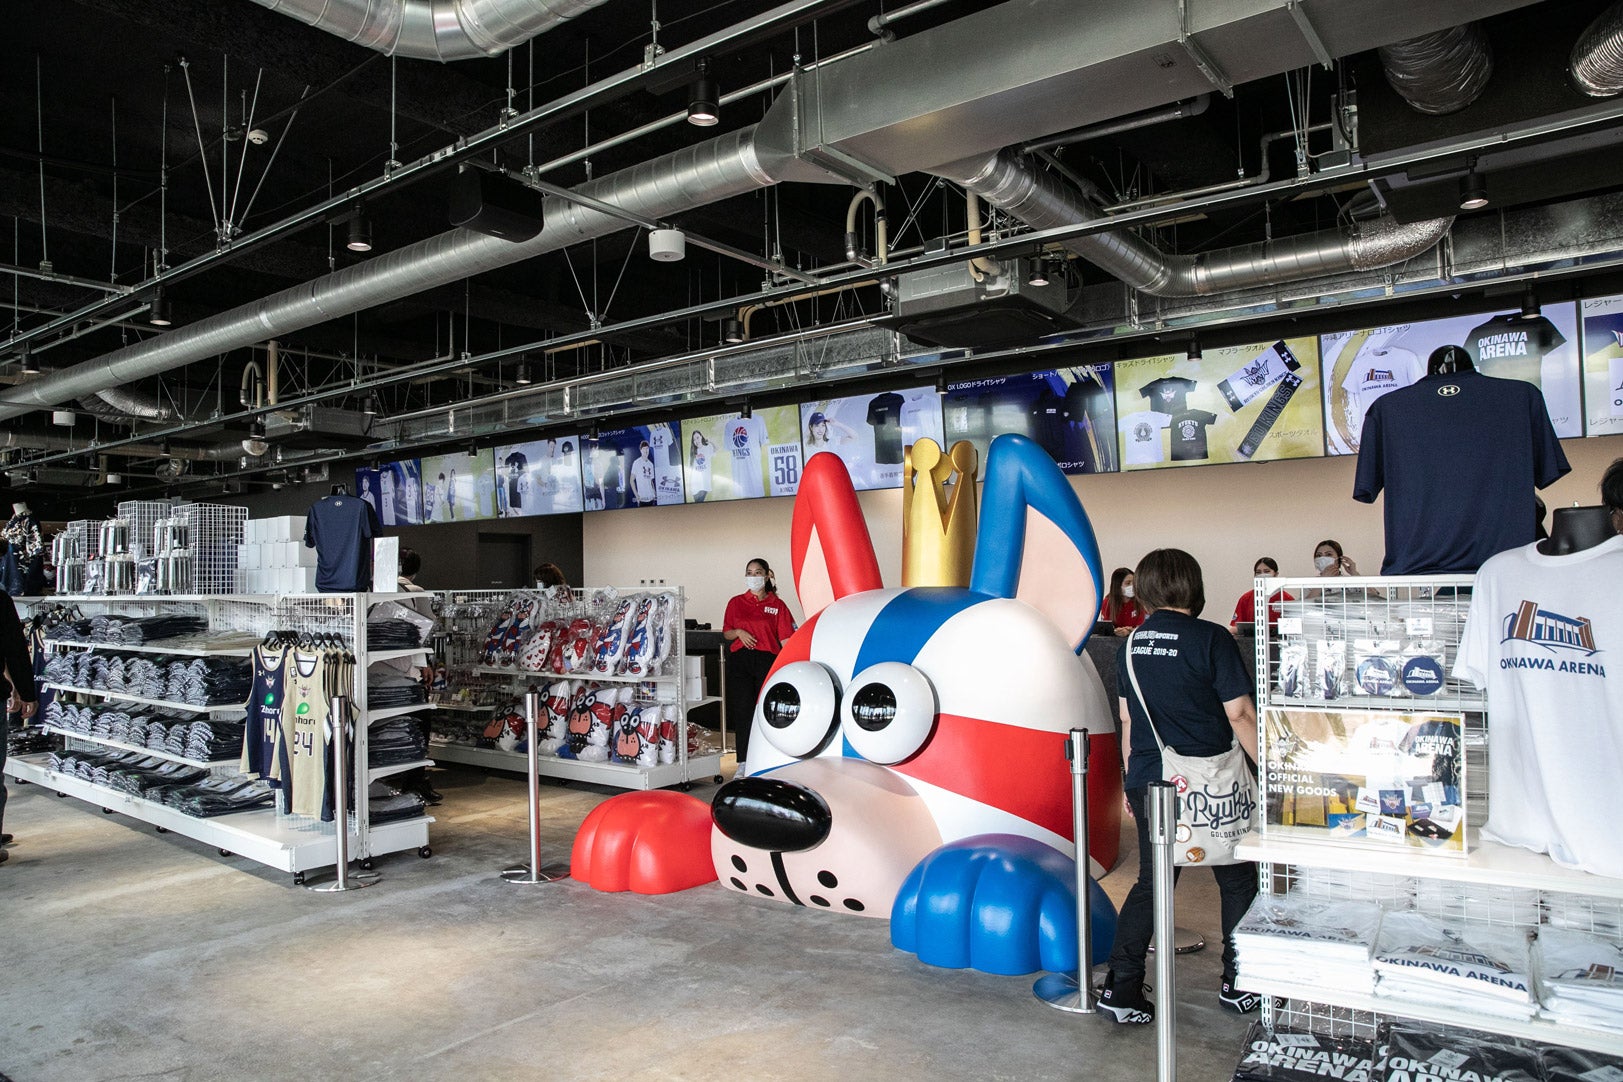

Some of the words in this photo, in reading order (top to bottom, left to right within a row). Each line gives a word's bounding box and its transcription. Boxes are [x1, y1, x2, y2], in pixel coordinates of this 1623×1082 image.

[1478, 331, 1528, 348] OKINAWA
[1480, 341, 1528, 361] ARENA
[1116, 355, 1176, 368] キッズドライTシャツ
[1261, 384, 1294, 427] KINGS
[732, 448, 751, 457] KINGS
[771, 445, 798, 455] OKINAWA
[774, 455, 798, 485] 58
[1153, 647, 1178, 657] 2019-20
[1500, 657, 1555, 670] OKNAWA
[1558, 660, 1606, 678] ARENA
[1414, 735, 1455, 745] OKINAWA
[1415, 742, 1453, 757] ARENA
[1268, 772, 1314, 784] OFFICIAL
[1268, 784, 1294, 793] NEW
[1296, 785, 1337, 797] GOODS
[1239, 925, 1312, 938] OKINAWA
[1375, 955, 1461, 977] OKINAWA
[1465, 970, 1528, 992] ARENA
[1251, 1040, 1373, 1071] OKINAWA
[1243, 1052, 1369, 1082] ARENA
